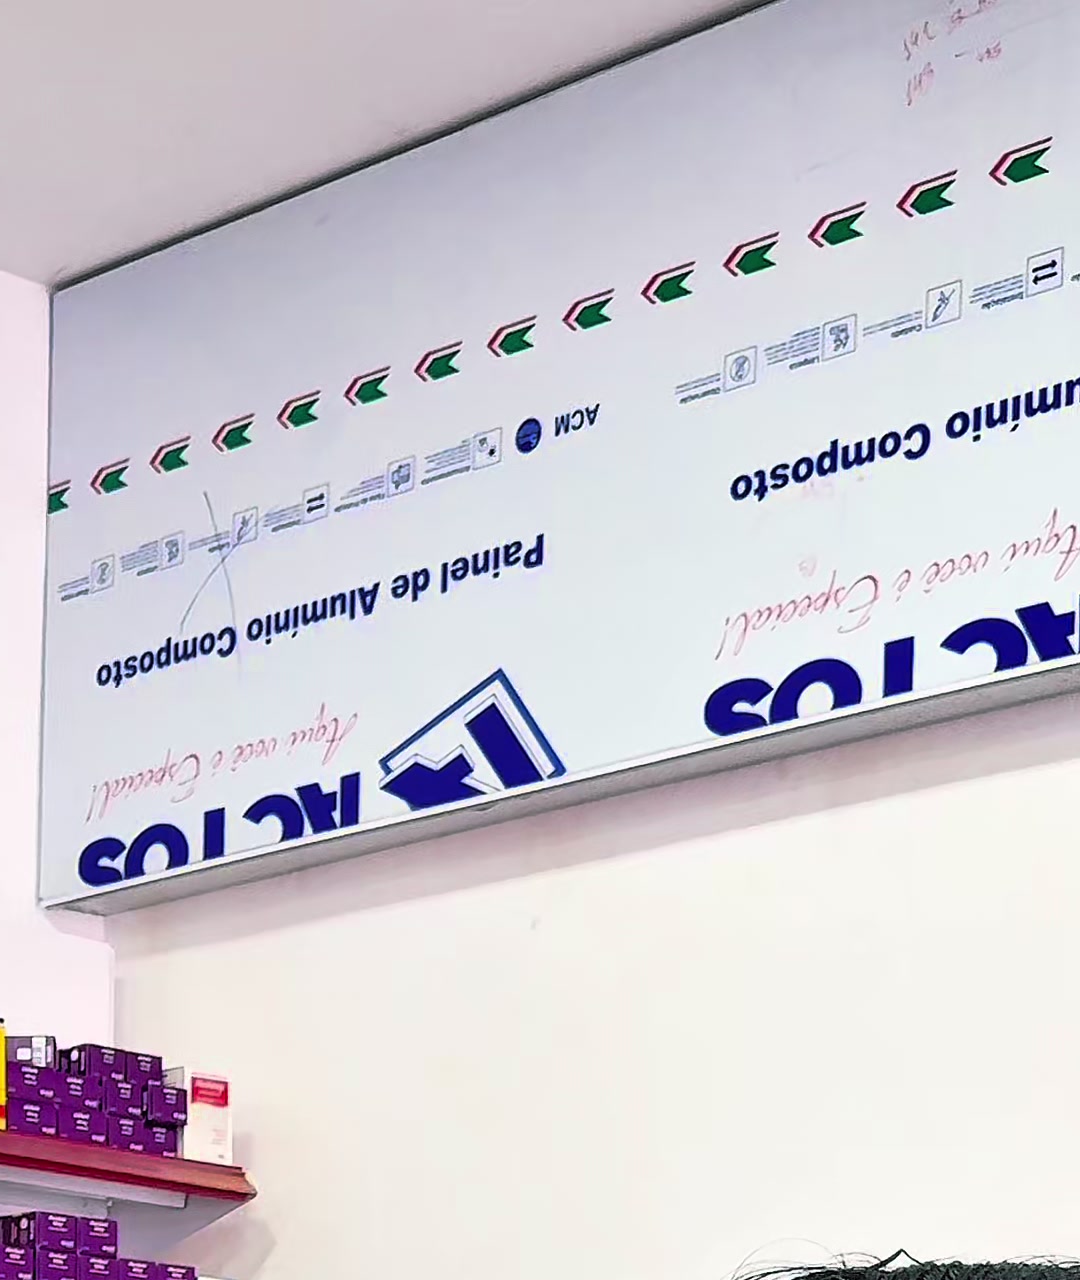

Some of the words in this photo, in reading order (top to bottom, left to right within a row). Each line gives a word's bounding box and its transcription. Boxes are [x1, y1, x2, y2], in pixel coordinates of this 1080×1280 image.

[553, 404, 601, 438] ACM
[730, 424, 932, 506] Composto
[391, 566, 431, 603] de
[439, 533, 546, 595] Painel
[923, 550, 990, 595] você
[246, 580, 381, 645] Alumínio
[95, 625, 238, 690] Composto
